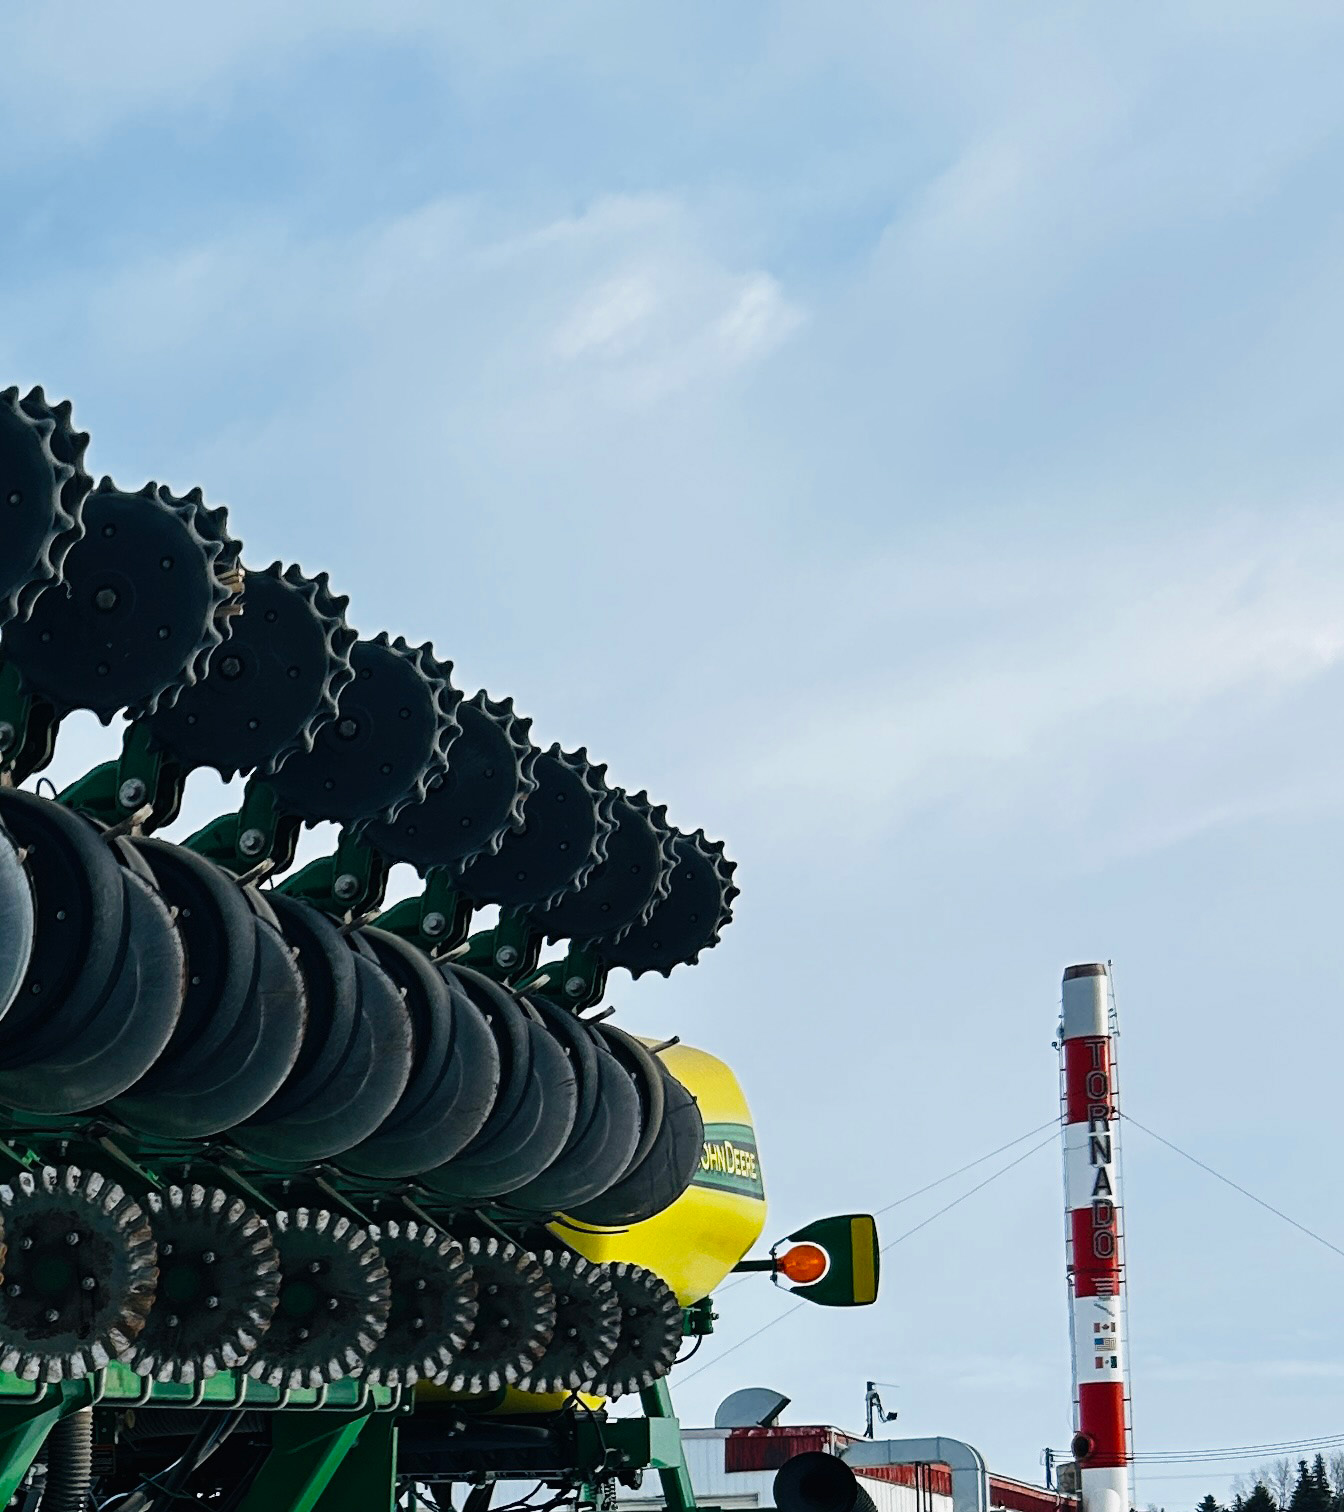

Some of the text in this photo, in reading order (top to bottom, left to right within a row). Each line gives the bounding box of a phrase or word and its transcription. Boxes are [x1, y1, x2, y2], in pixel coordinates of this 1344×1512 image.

[698, 1140, 758, 1180] OHN DEERE
[1083, 1039, 1116, 1260] TORNADO
